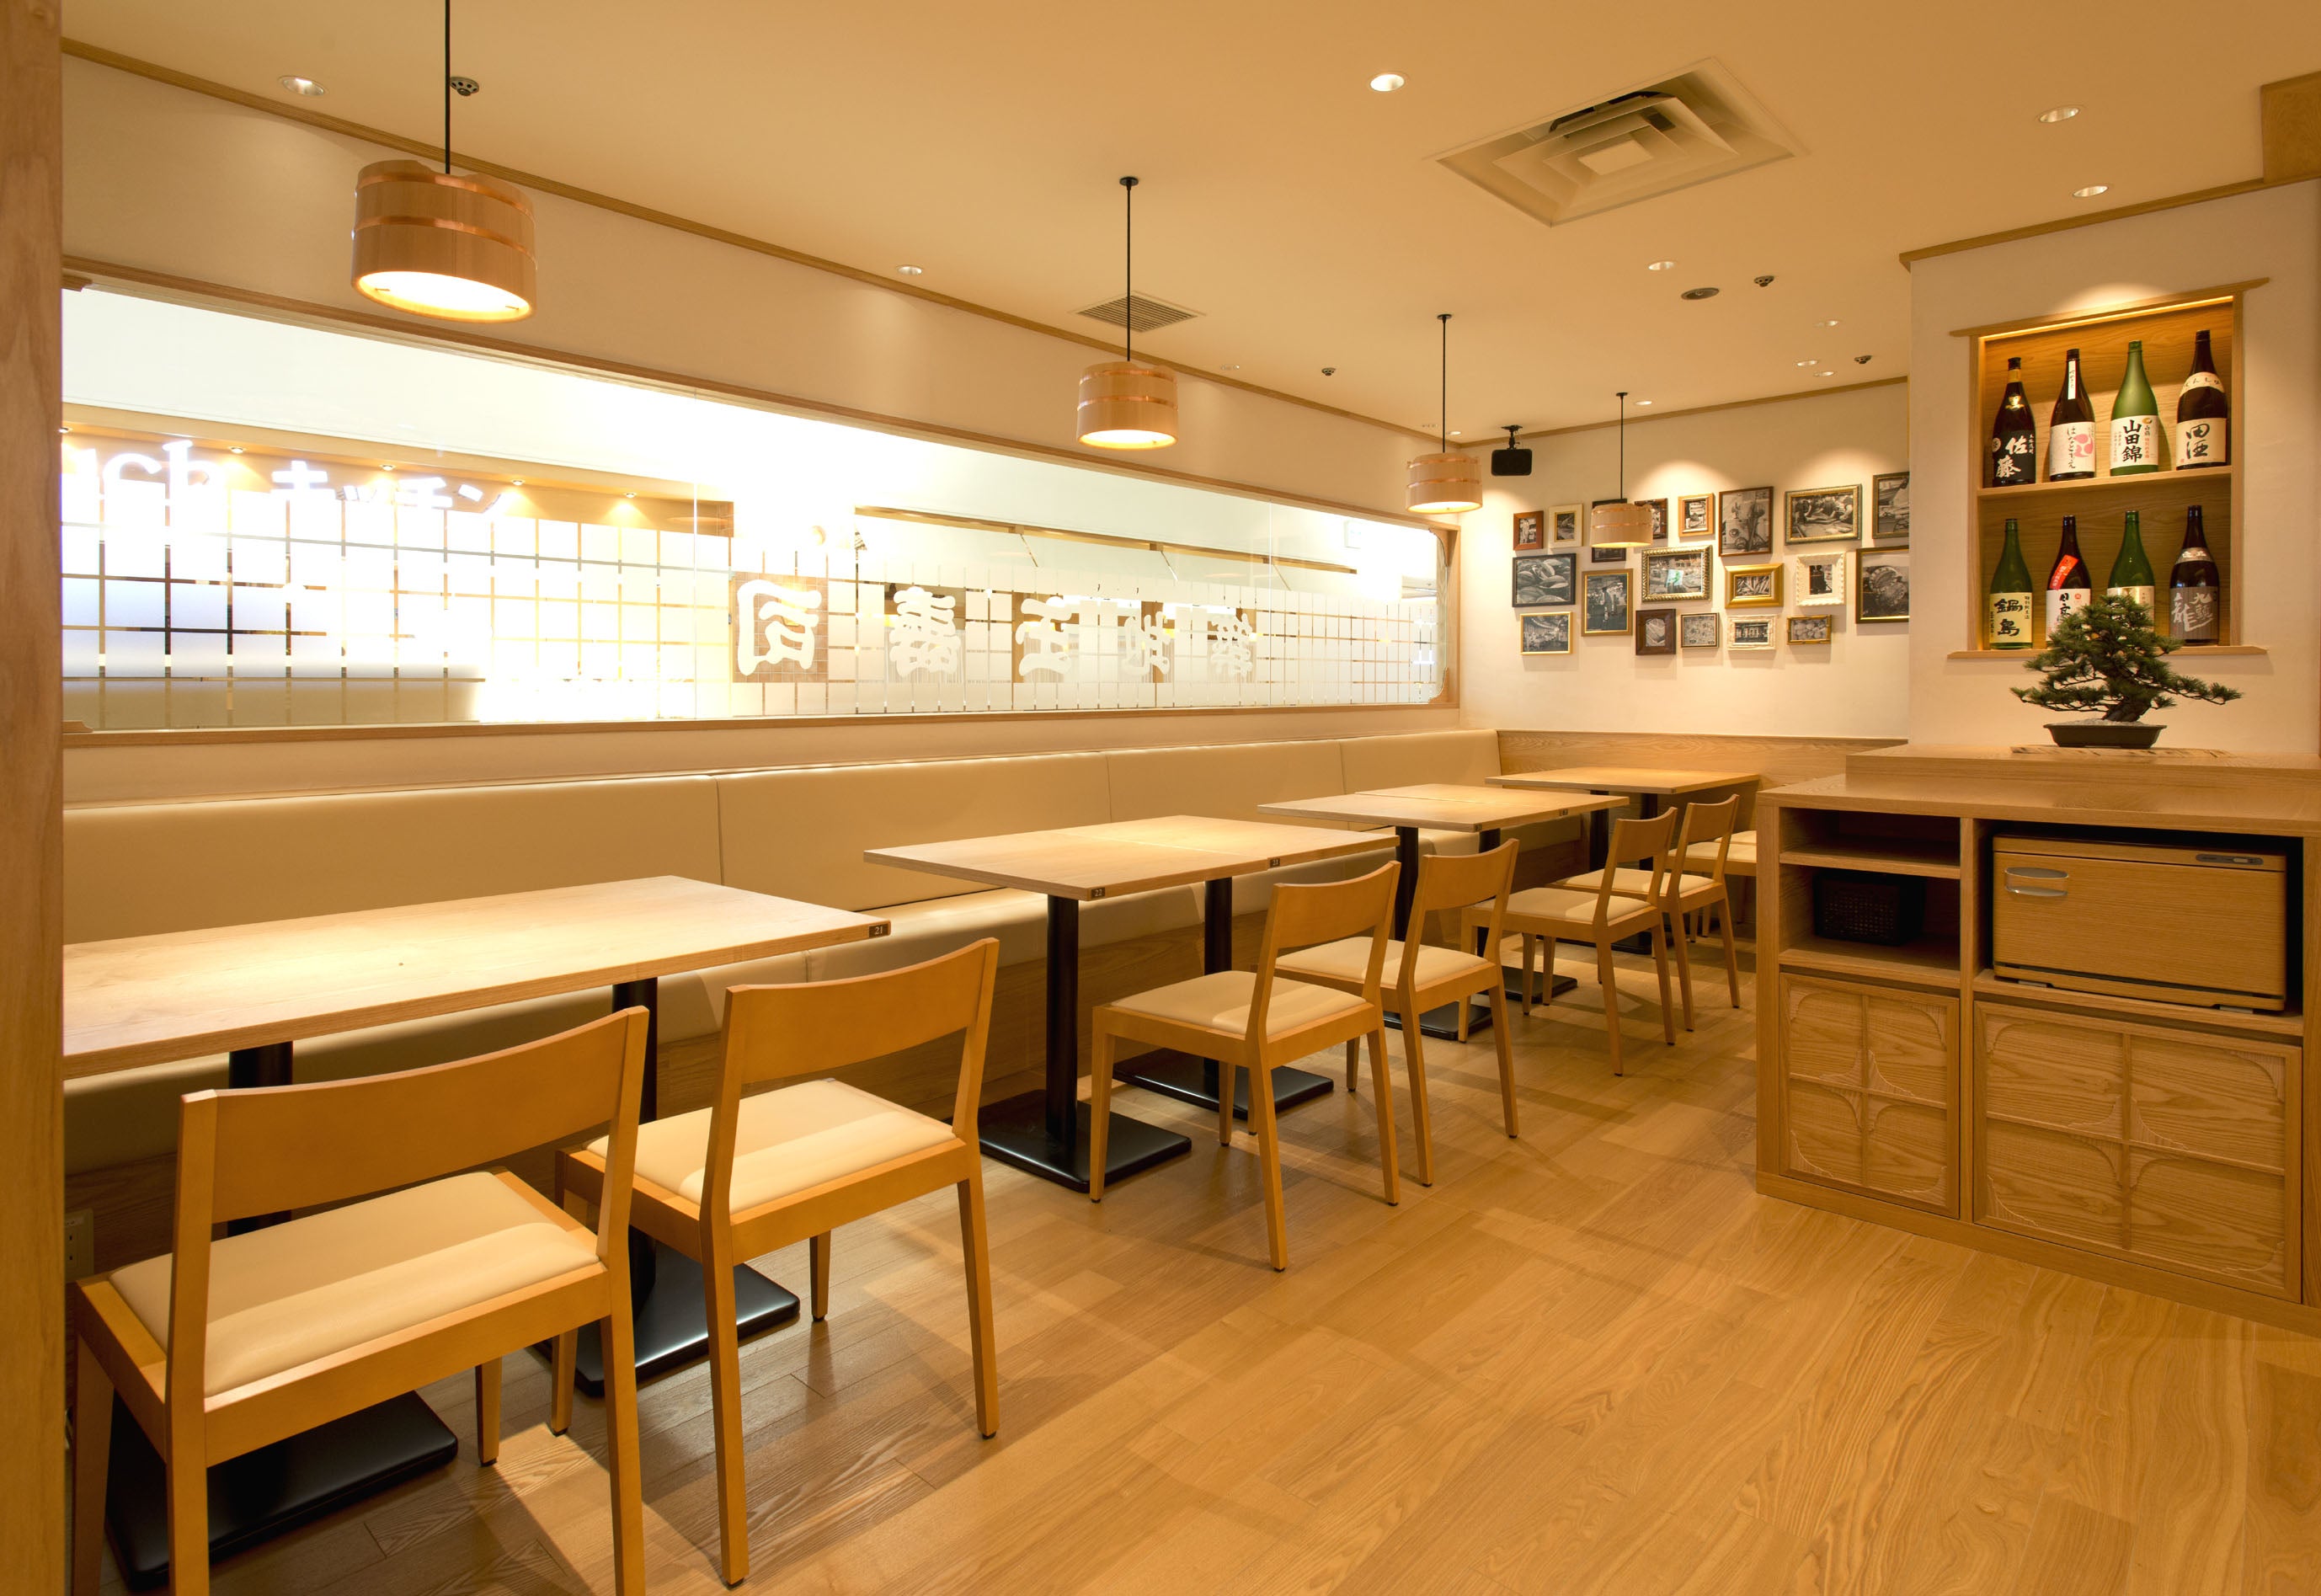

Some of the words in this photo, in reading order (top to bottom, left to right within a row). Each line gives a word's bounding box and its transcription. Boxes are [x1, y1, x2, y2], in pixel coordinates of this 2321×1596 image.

[1996, 435, 2028, 478] 佐藤
[2122, 419, 2142, 462] 山田錦
[2185, 424, 2210, 459] 田酒
[1993, 598, 2023, 637] 鍋島
[2058, 593, 2071, 622] 日高
[875, 926, 883, 935] 21
